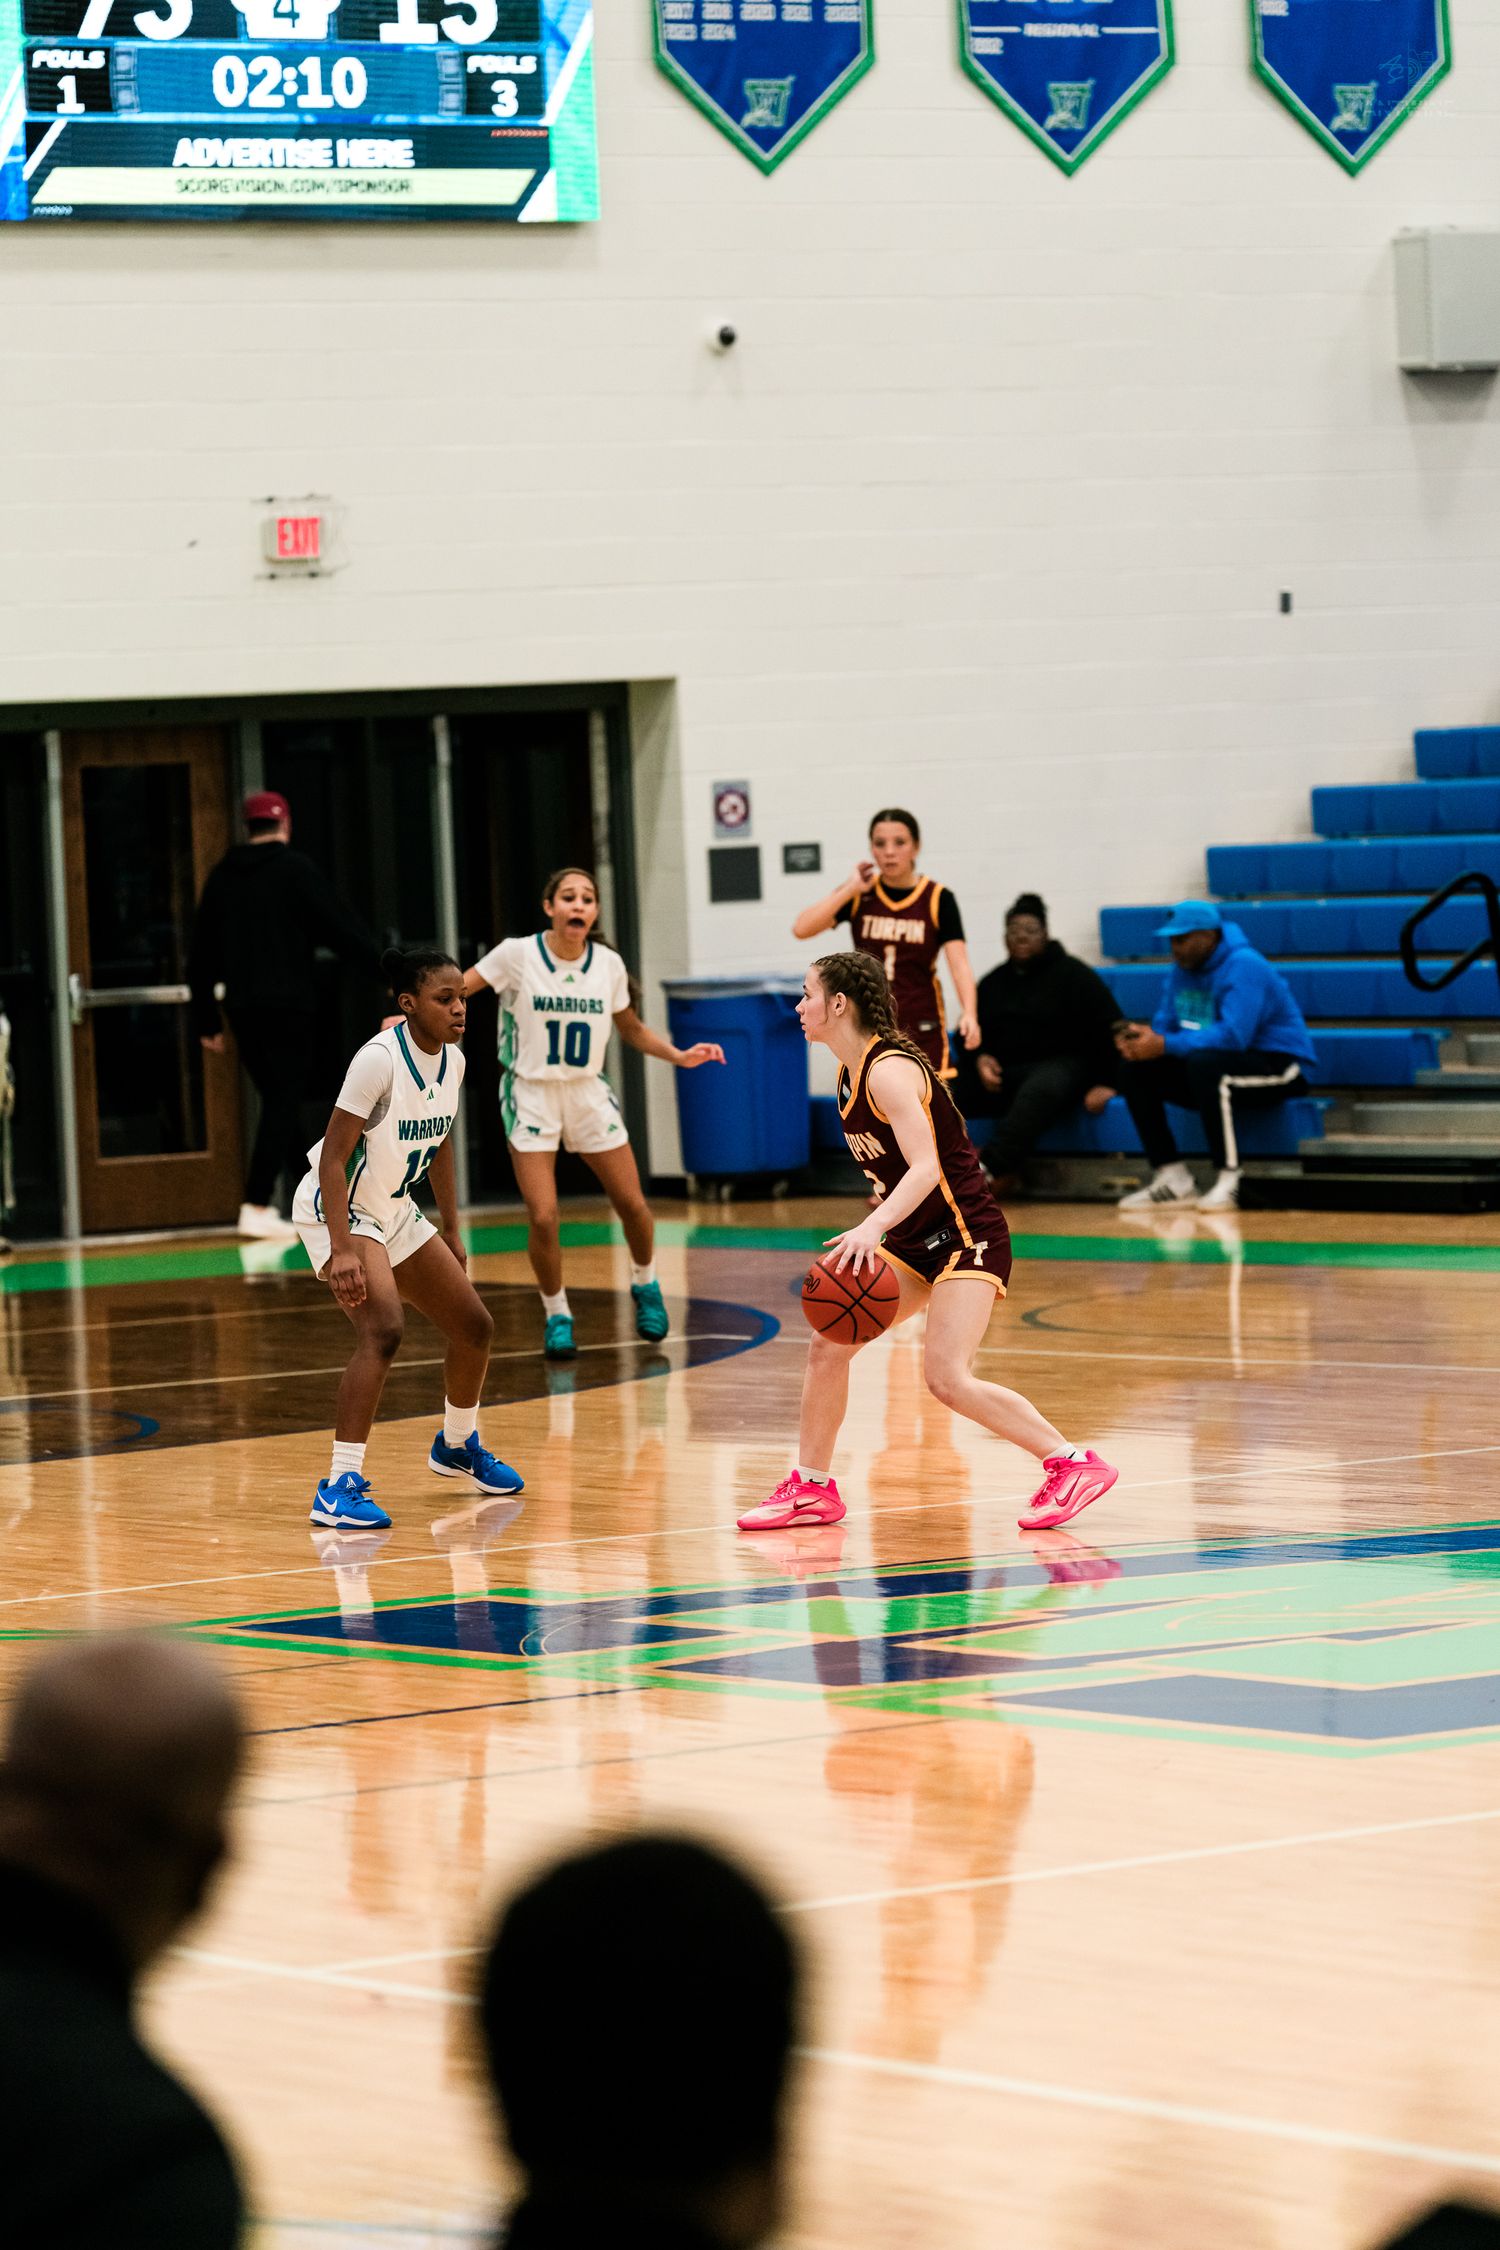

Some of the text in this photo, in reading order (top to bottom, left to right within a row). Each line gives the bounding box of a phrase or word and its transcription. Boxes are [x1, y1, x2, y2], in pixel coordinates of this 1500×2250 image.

[32, 50, 105, 69] FOULS
[467, 54, 537, 74] FOULS
[56, 75, 85, 114] 1
[212, 55, 367, 108] 02:10
[491, 80, 519, 117] 3
[172, 138, 415, 168] ADVERTISE HERE
[278, 517, 320, 558] EXIT
[862, 914, 926, 944] TURPIN
[533, 996, 604, 1014] WARRIORS
[545, 1020, 591, 1067] 10
[969, 1240, 989, 1267] T
